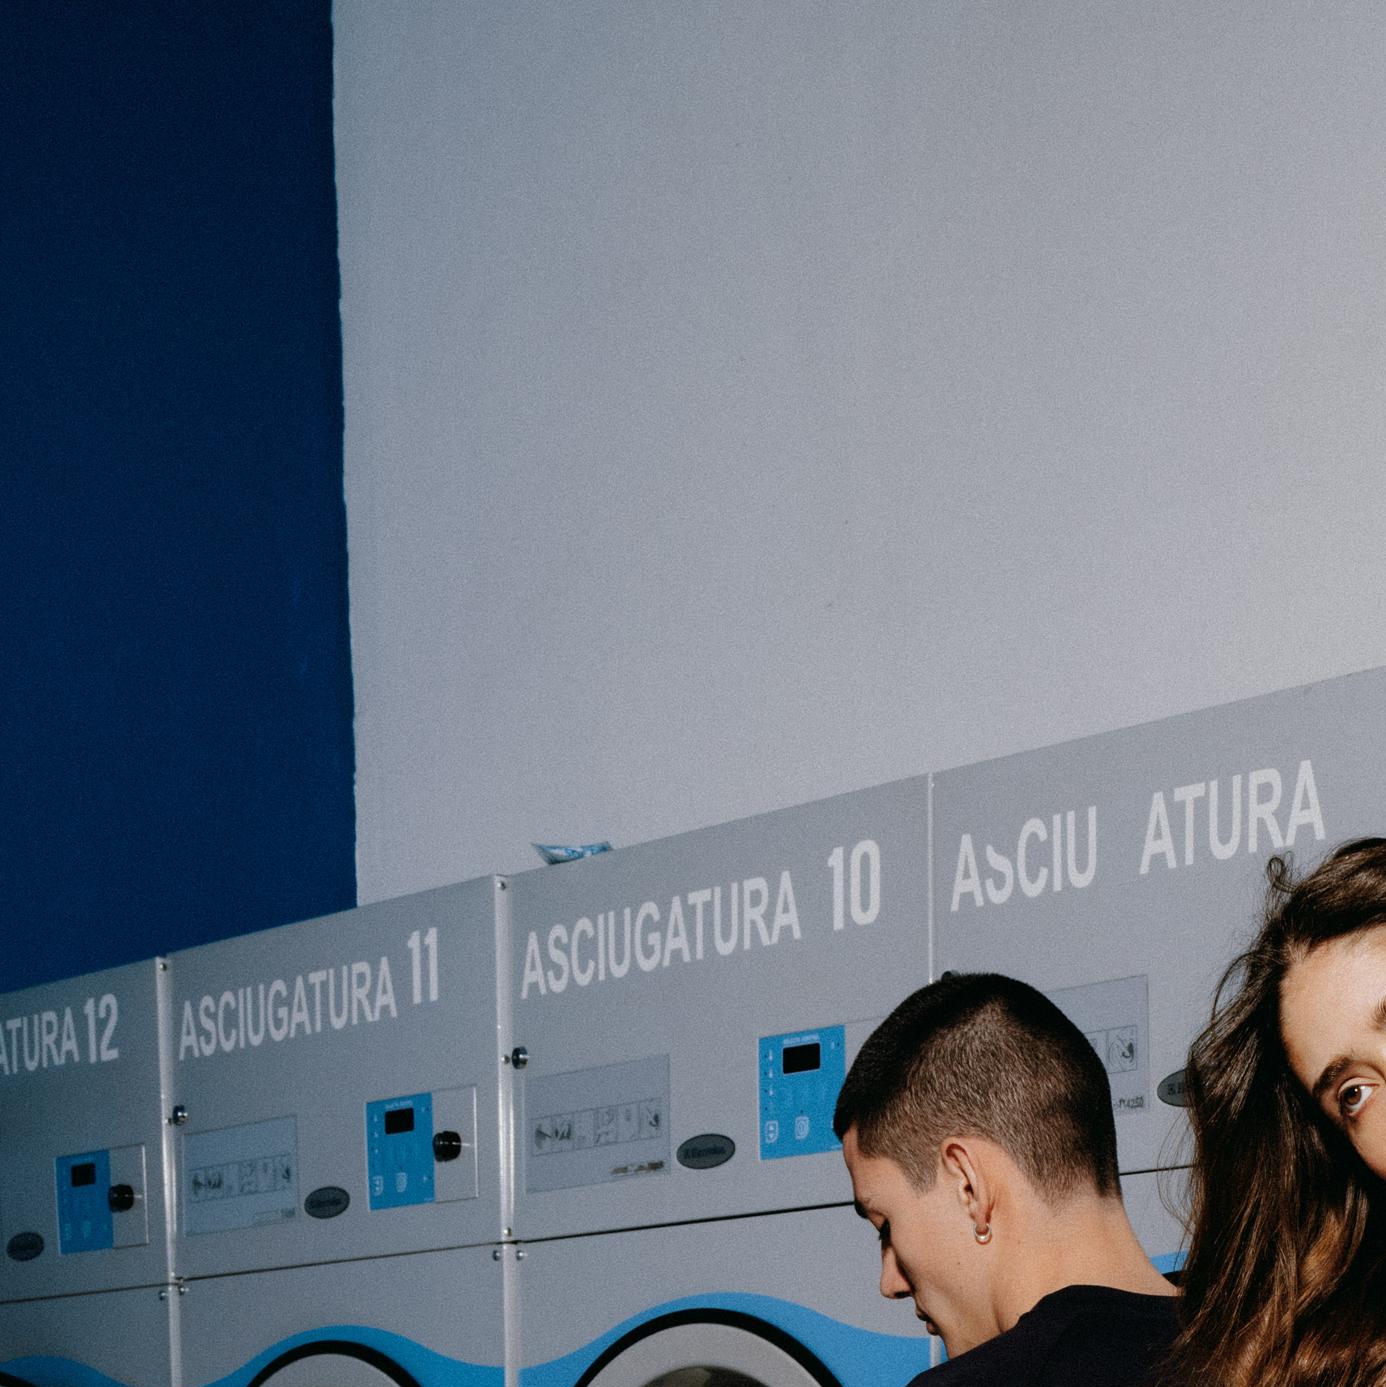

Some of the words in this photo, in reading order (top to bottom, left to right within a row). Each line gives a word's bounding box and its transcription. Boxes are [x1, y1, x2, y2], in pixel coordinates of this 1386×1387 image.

[521, 871, 801, 999] ASCIUGATURA
[827, 839, 881, 931] 10
[84, 993, 119, 1064] 12
[179, 956, 398, 1061] ASCIUGATURA
[408, 927, 440, 1004] 11
